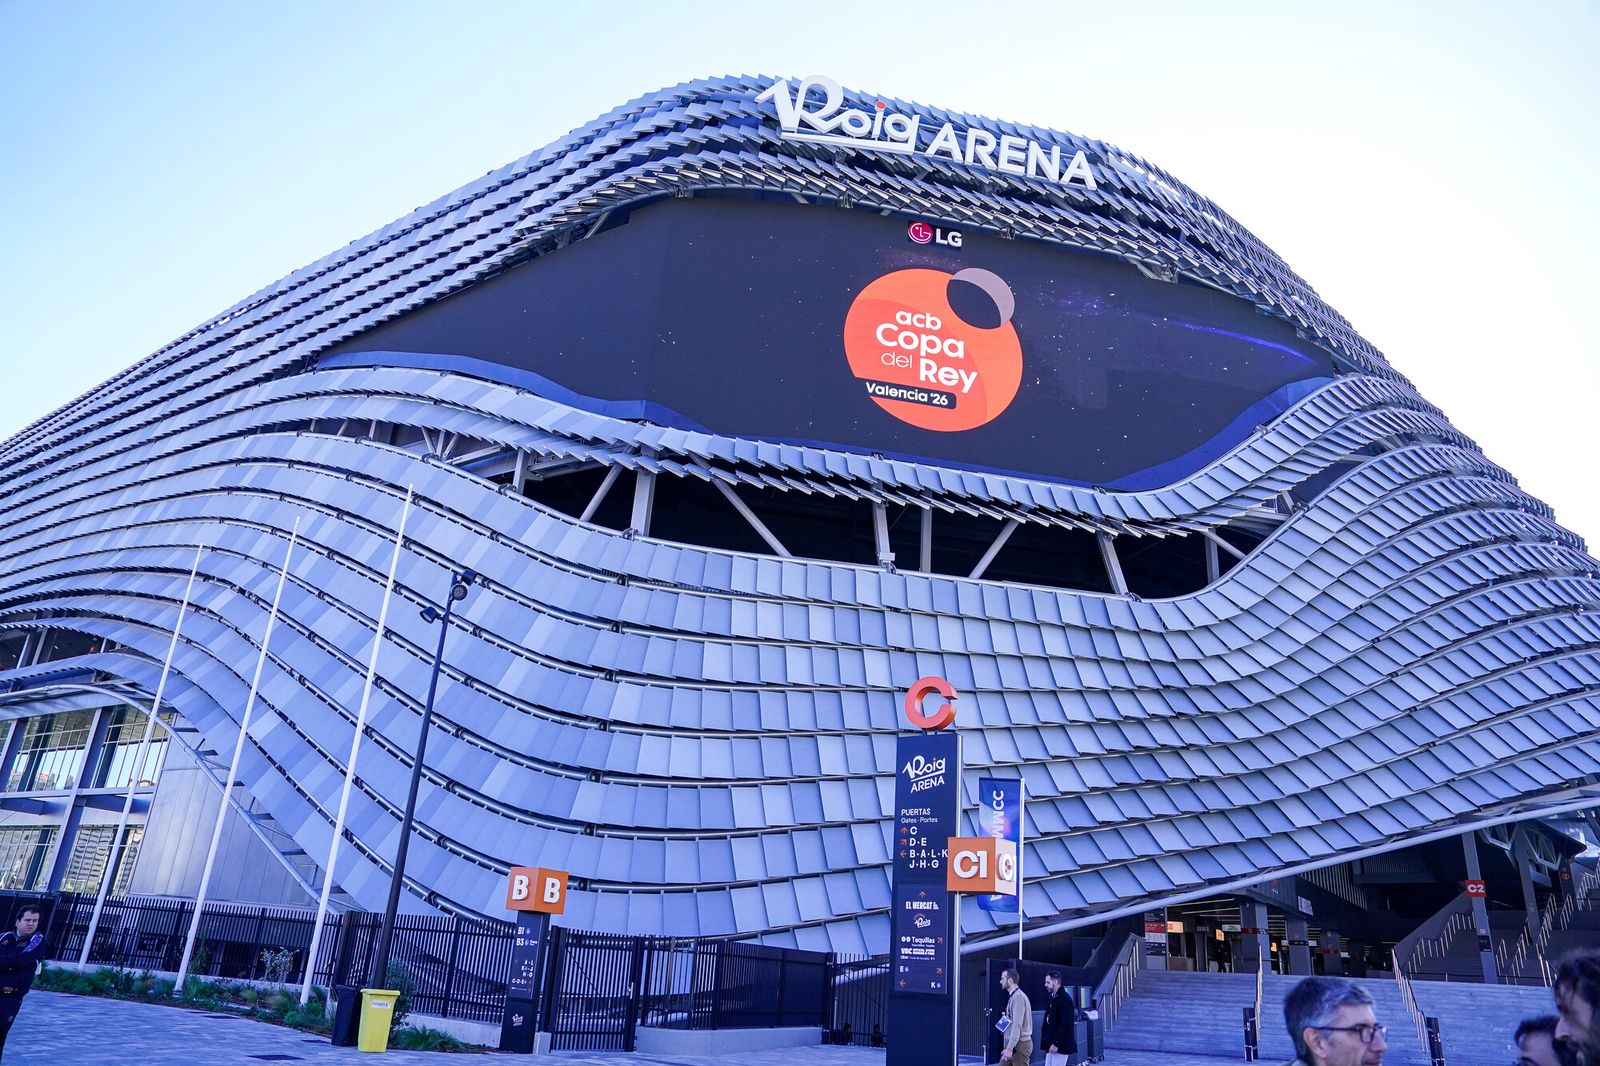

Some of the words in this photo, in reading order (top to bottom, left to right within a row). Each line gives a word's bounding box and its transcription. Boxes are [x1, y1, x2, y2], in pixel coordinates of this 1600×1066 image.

[754, 74, 920, 155] Roig
[924, 122, 1098, 191] ARENA
[935, 228, 963, 247] LG
[895, 310, 943, 331] acb
[875, 323, 966, 359] Copa
[880, 351, 913, 369] del
[919, 358, 979, 394] Rey
[865, 382, 929, 404] Valencia
[905, 675, 958, 730] C
[902, 755, 946, 782] Roig
[910, 775, 945, 794] ARENA
[901, 808, 931, 816] PUERTAS
[909, 826, 918, 835] C
[953, 850, 988, 879] C1
[512, 874, 529, 901] B
[543, 877, 561, 904] B
[1467, 884, 1485, 893] C2
[911, 936, 935, 944] Taquillas
